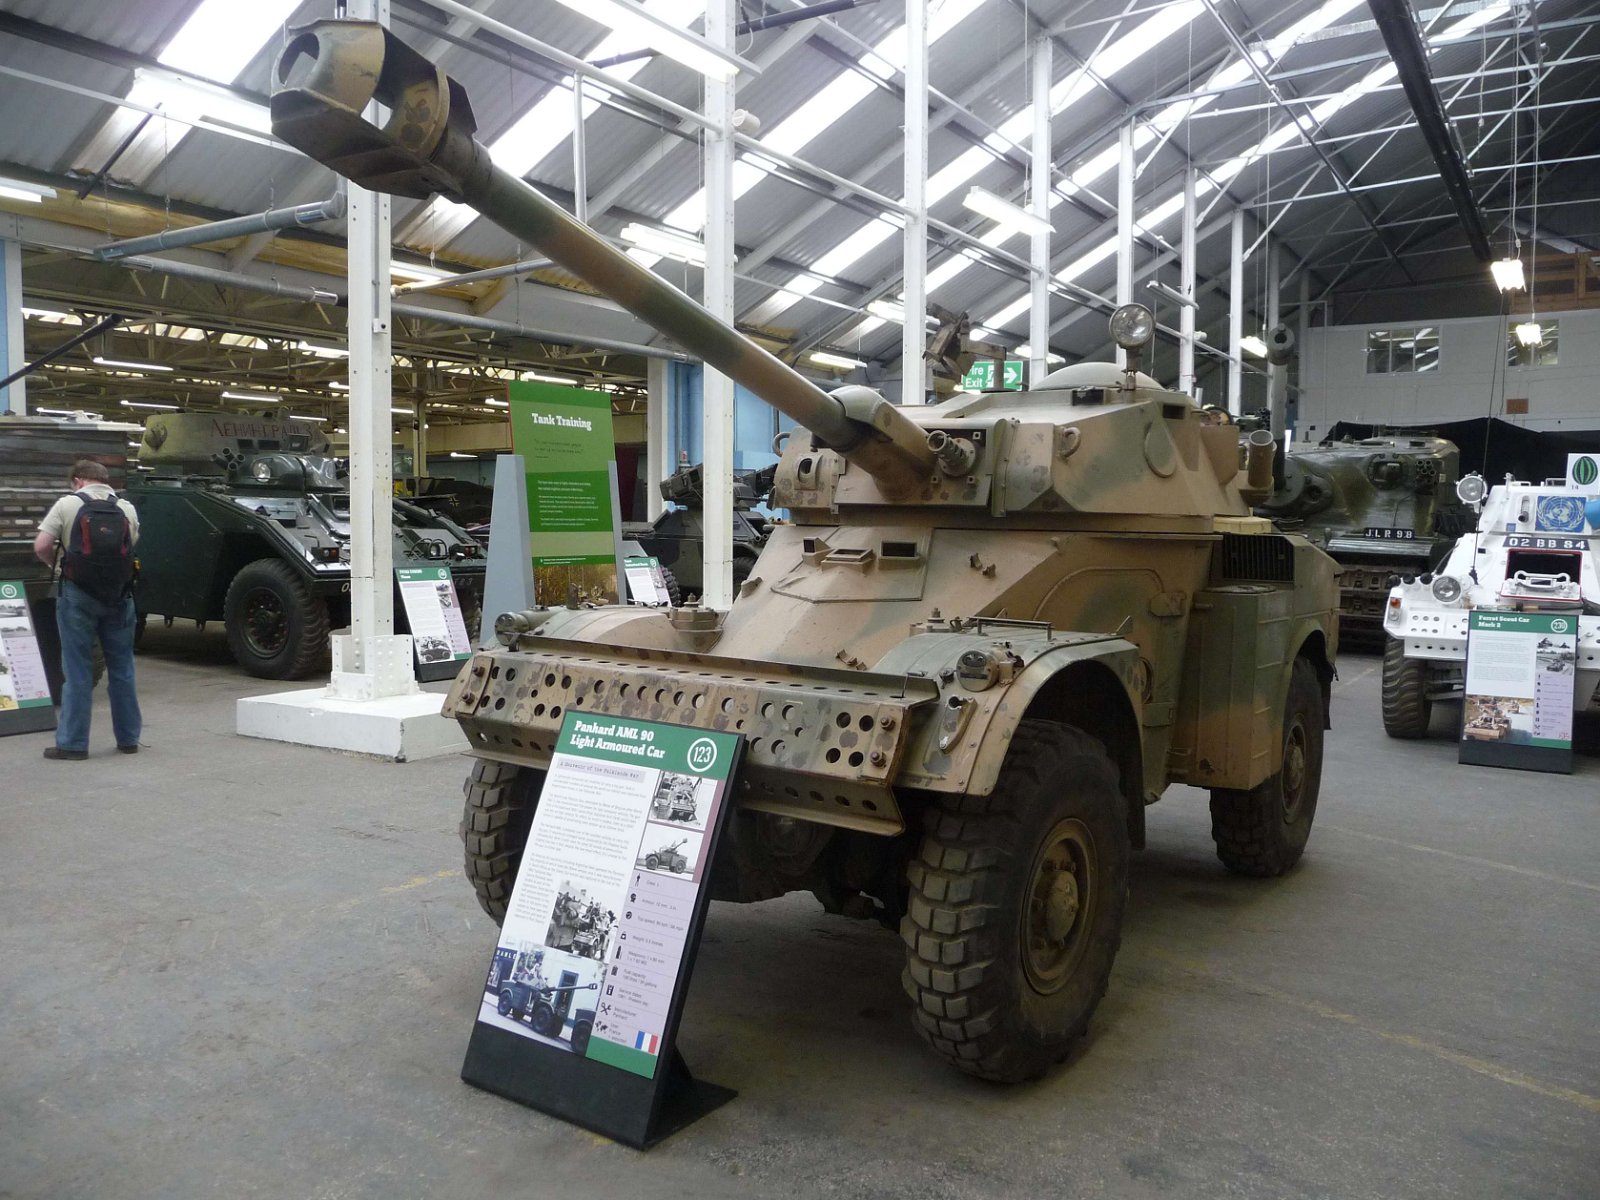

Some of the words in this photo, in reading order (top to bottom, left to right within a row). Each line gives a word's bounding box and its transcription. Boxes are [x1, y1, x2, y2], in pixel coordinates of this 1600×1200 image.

[970, 366, 984, 375] ire
[965, 377, 983, 388] Exit
[531, 412, 555, 425] Tank
[556, 415, 592, 431] Training
[1509, 537, 1531, 547] 02
[1536, 538, 1557, 548] BB
[1563, 540, 1586, 550] 84
[1499, 615, 1518, 623] Scout
[574, 720, 615, 736] Panhard
[615, 725, 639, 740] AML
[640, 729, 655, 742] 90
[570, 734, 596, 750] Light
[595, 738, 647, 756] Armoured
[646, 745, 666, 759] Car
[692, 746, 712, 763] 123
